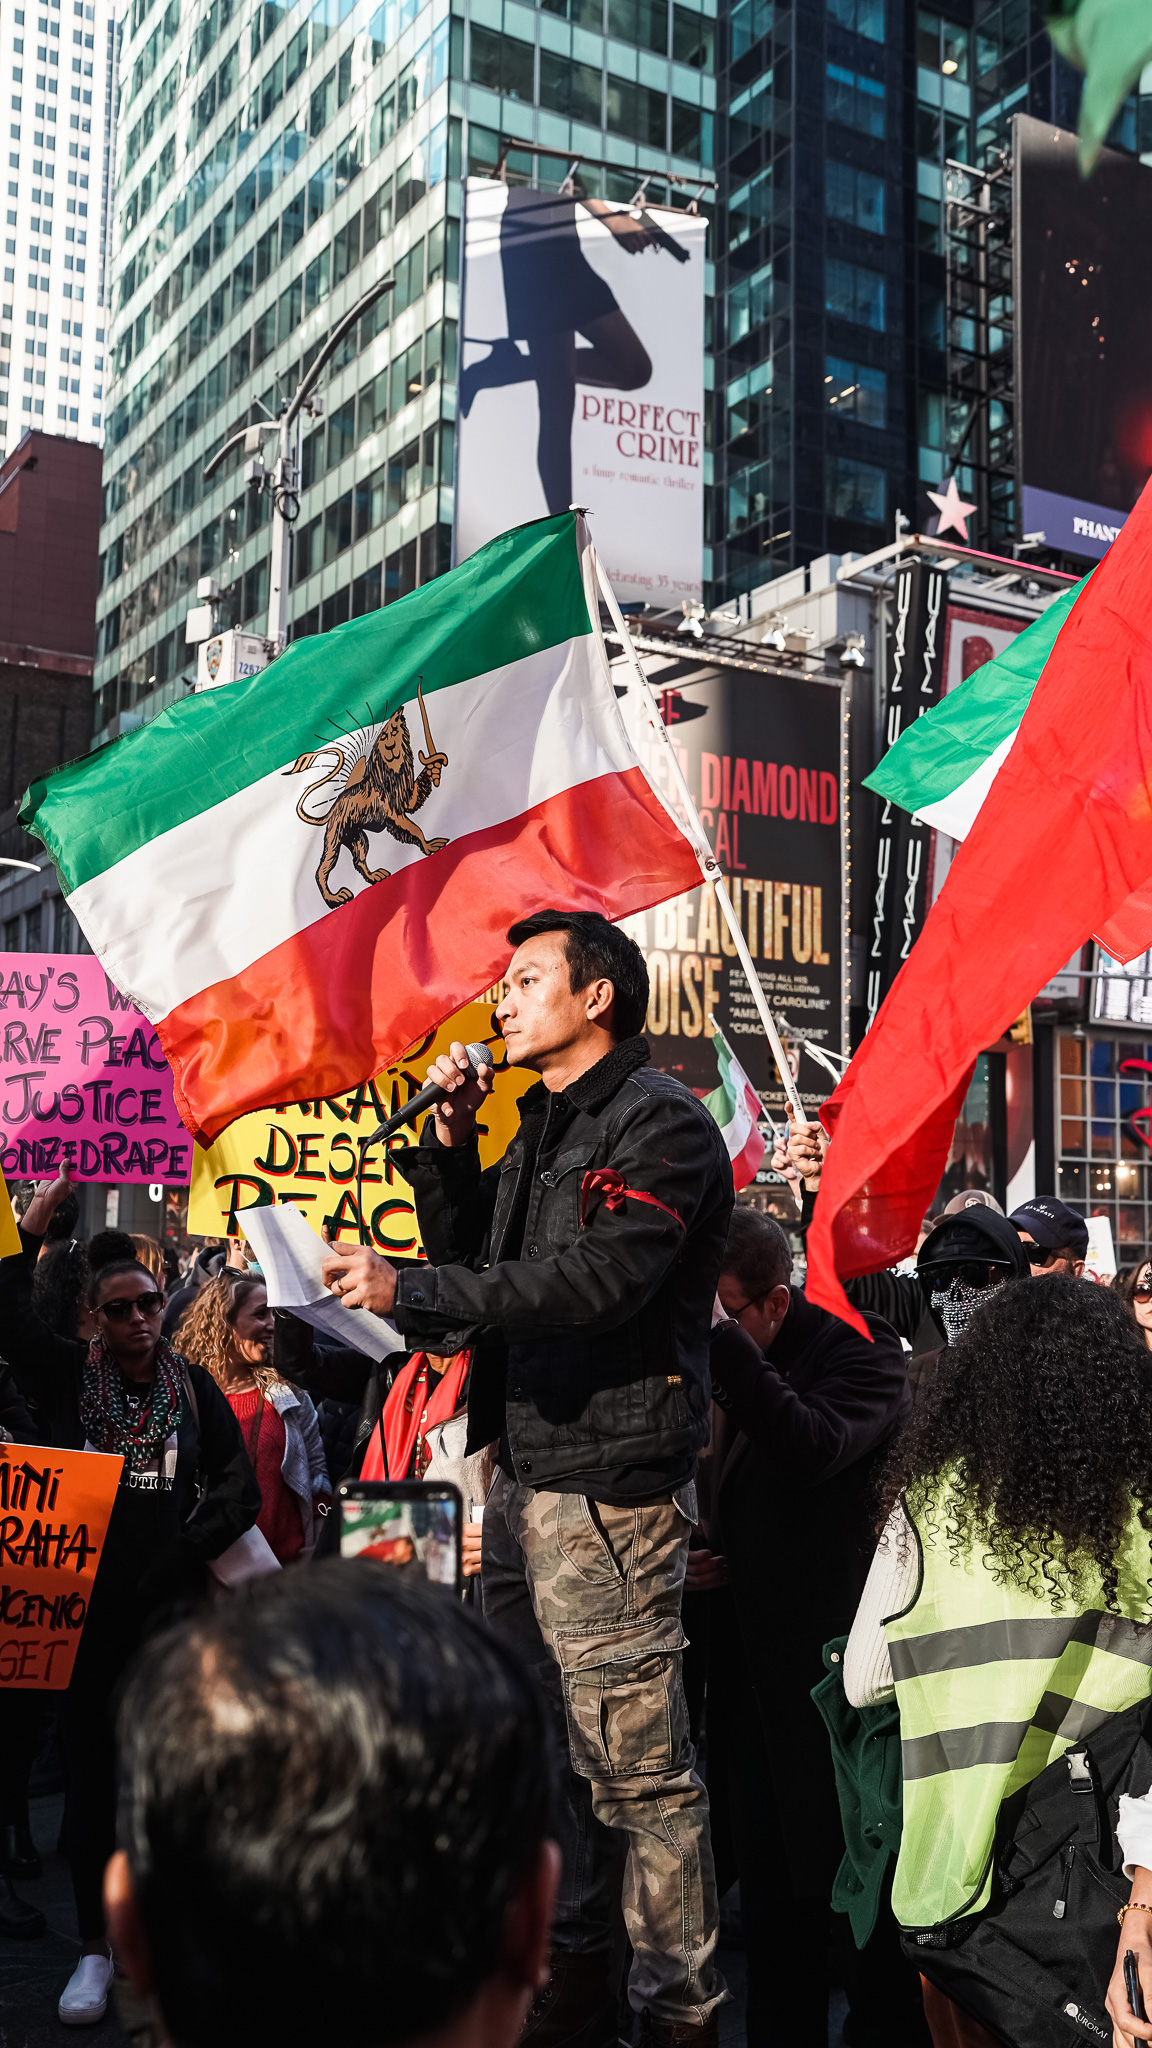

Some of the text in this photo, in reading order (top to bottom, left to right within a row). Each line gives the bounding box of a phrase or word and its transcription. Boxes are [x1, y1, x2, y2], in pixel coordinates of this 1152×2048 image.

[582, 395, 700, 438] PERFECT
[617, 431, 699, 468] CRIME
[592, 464, 616, 483] funny
[619, 471, 660, 486] romantic
[663, 475, 695, 491] thriller
[701, 751, 838, 826] DIAMOND
[655, 874, 830, 966] BEAUTIFUL
[642, 950, 722, 1039] OISE
[0, 1020, 62, 1066] RVE
[2, 1070, 167, 1127] JUSTICE
